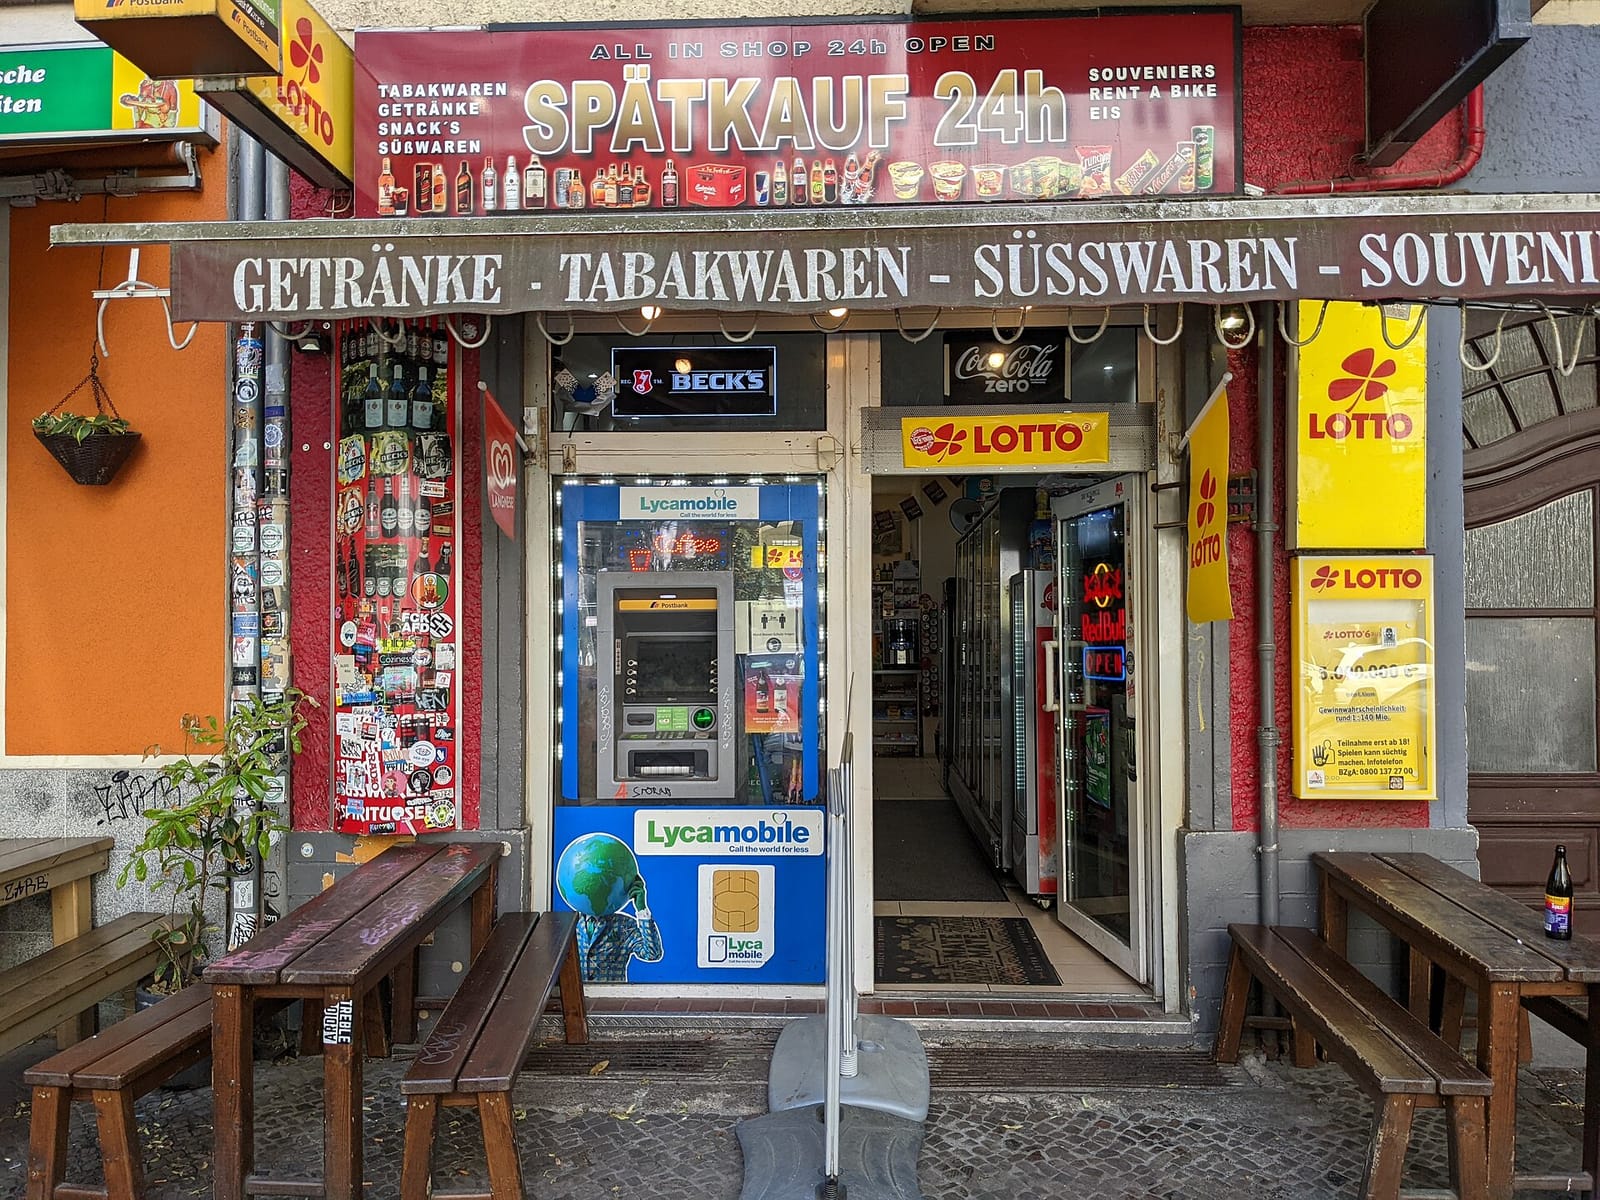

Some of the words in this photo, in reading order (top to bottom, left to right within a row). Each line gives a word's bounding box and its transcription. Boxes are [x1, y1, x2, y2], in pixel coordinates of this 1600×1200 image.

[590, 43, 652, 59] ALL
[669, 43, 703, 58] IN
[720, 41, 811, 58] SHOP
[828, 39, 887, 55] 24h
[905, 35, 995, 53] OPEN
[1089, 64, 1216, 82] SOUVENIERS
[378, 82, 507, 98] TABAKWAREN
[1089, 86, 1141, 101] RENT
[1150, 85, 1161, 99] A
[1170, 84, 1217, 98] BIKE
[277, 75, 335, 147] LOTTO
[378, 101, 480, 117] GETRÄNKE
[523, 63, 909, 155] SPÄTKAUF
[933, 69, 1067, 146] 24h
[1090, 106, 1121, 120] EIS
[378, 139, 481, 155] SÜßWAREN
[233, 243, 503, 313] GETRÄNKE
[559, 247, 912, 303] TABAKWAREN
[974, 230, 1299, 298] SÜSSWAREN
[1359, 231, 1600, 288] SOUVENI
[672, 369, 765, 391] BECK'S
[984, 378, 1030, 393] zero
[1309, 413, 1413, 440] LOTTO
[974, 423, 1083, 454] LOTTO
[640, 496, 737, 514] Lycamobile
[654, 534, 720, 554] Coffee
[1191, 533, 1220, 569] LOTTO
[1344, 568, 1422, 589] LOTTO
[661, 601, 689, 609] Postbank
[402, 613, 430, 622] FCK
[402, 622, 430, 632] AFD
[1086, 653, 1122, 674] OPEN
[1337, 739, 1372, 747] Teilnahme
[1399, 738, 1410, 746] 18!
[1337, 749, 1362, 757] Spielen
[1382, 748, 1407, 757] süchtig
[1339, 768, 1359, 777] BZgA:
[1380, 767, 1392, 775] 137
[1394, 767, 1402, 775] 27
[1403, 767, 1413, 775] 00
[647, 820, 810, 848] Lycamobile
[729, 845, 744, 854] Call
[745, 845, 758, 853] the
[759, 845, 781, 853] world
[782, 845, 793, 853] for
[793, 845, 809, 854] less
[728, 937, 763, 952] Lyca
[728, 950, 763, 959] mobile
[338, 1000, 353, 1044] TREBLE
